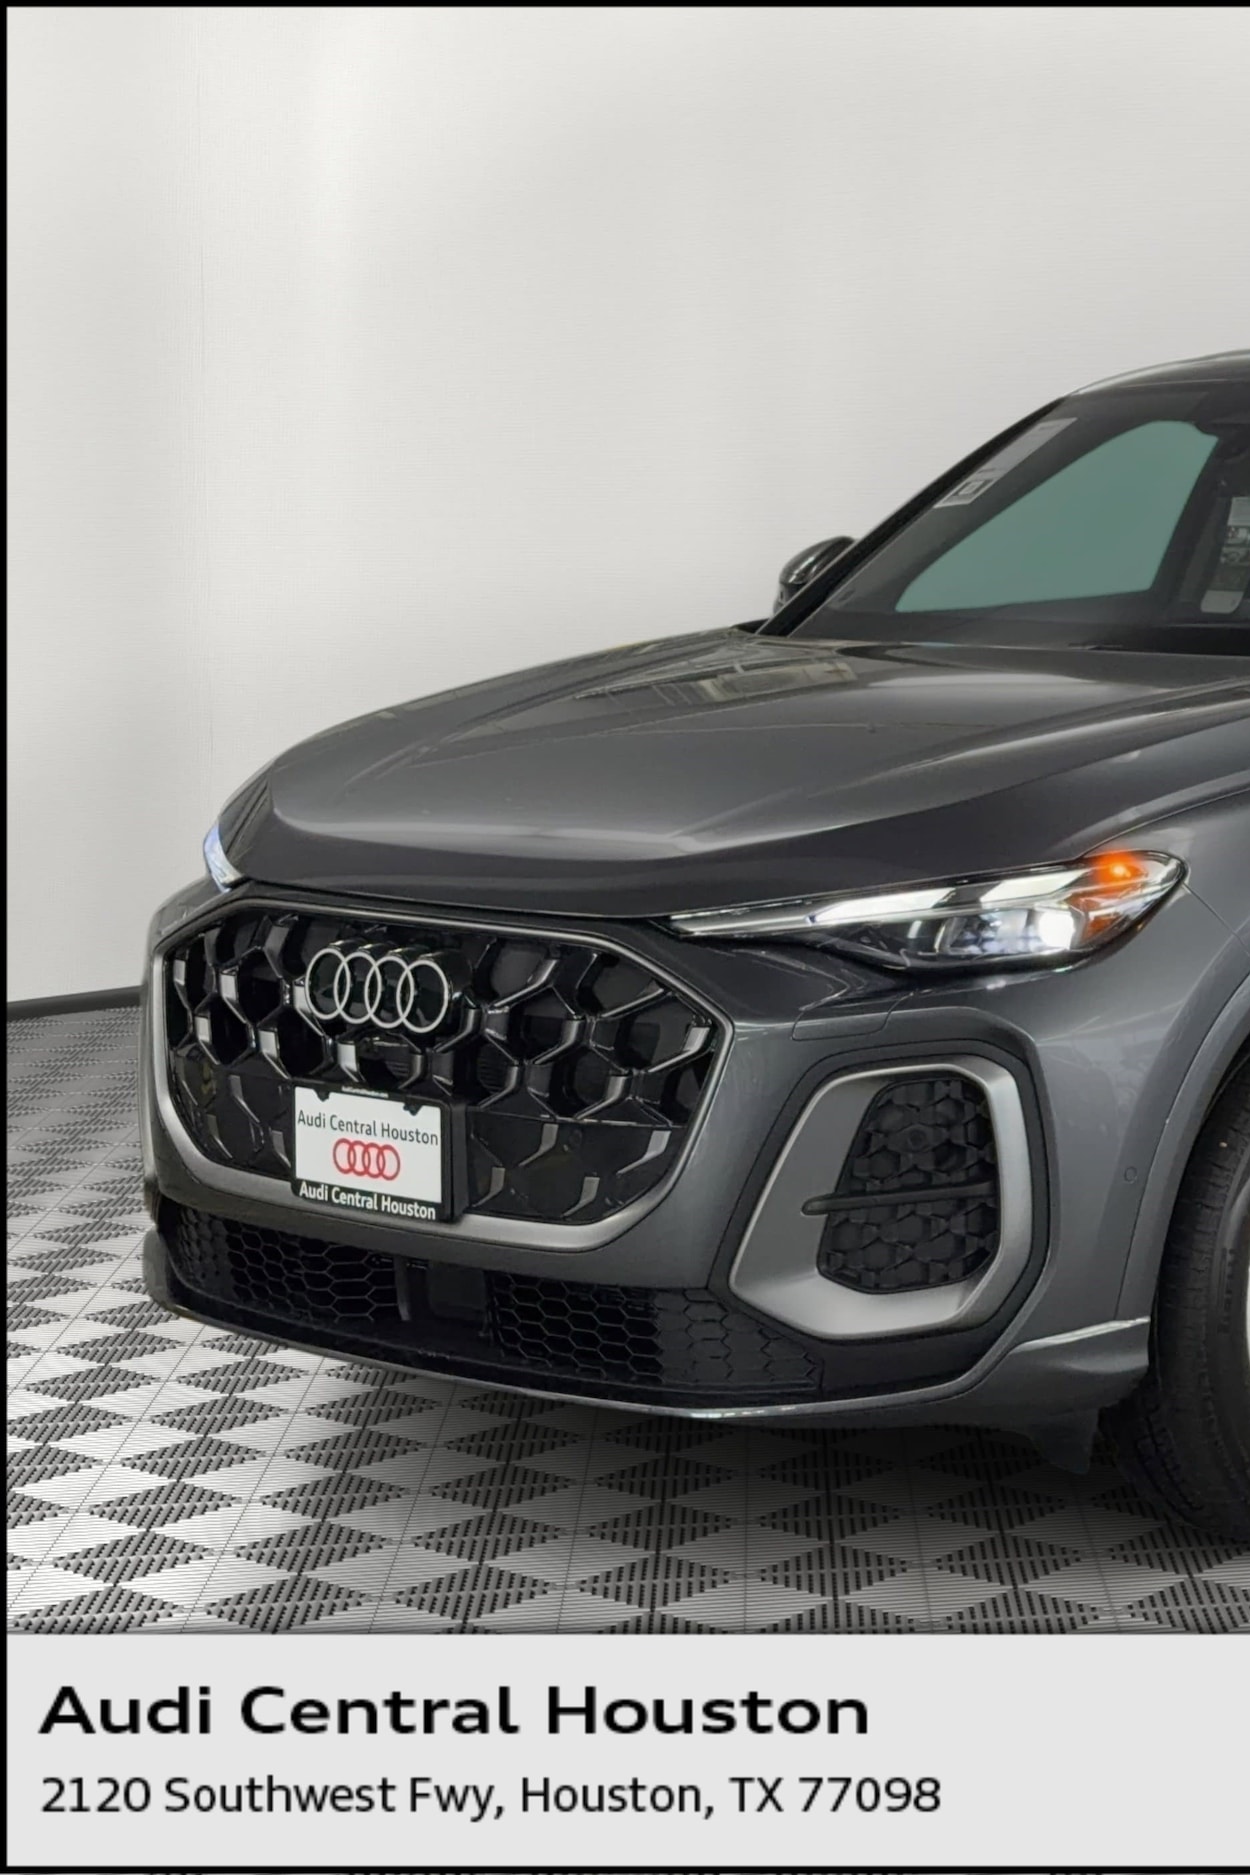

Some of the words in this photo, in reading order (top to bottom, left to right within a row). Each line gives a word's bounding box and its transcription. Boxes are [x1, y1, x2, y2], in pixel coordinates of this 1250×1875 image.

[297, 1109, 326, 1129] Audi
[330, 1114, 377, 1137] Central
[381, 1122, 439, 1146] Houston
[299, 1180, 328, 1202] Audi
[331, 1186, 378, 1210] Central
[381, 1194, 436, 1220] Houston
